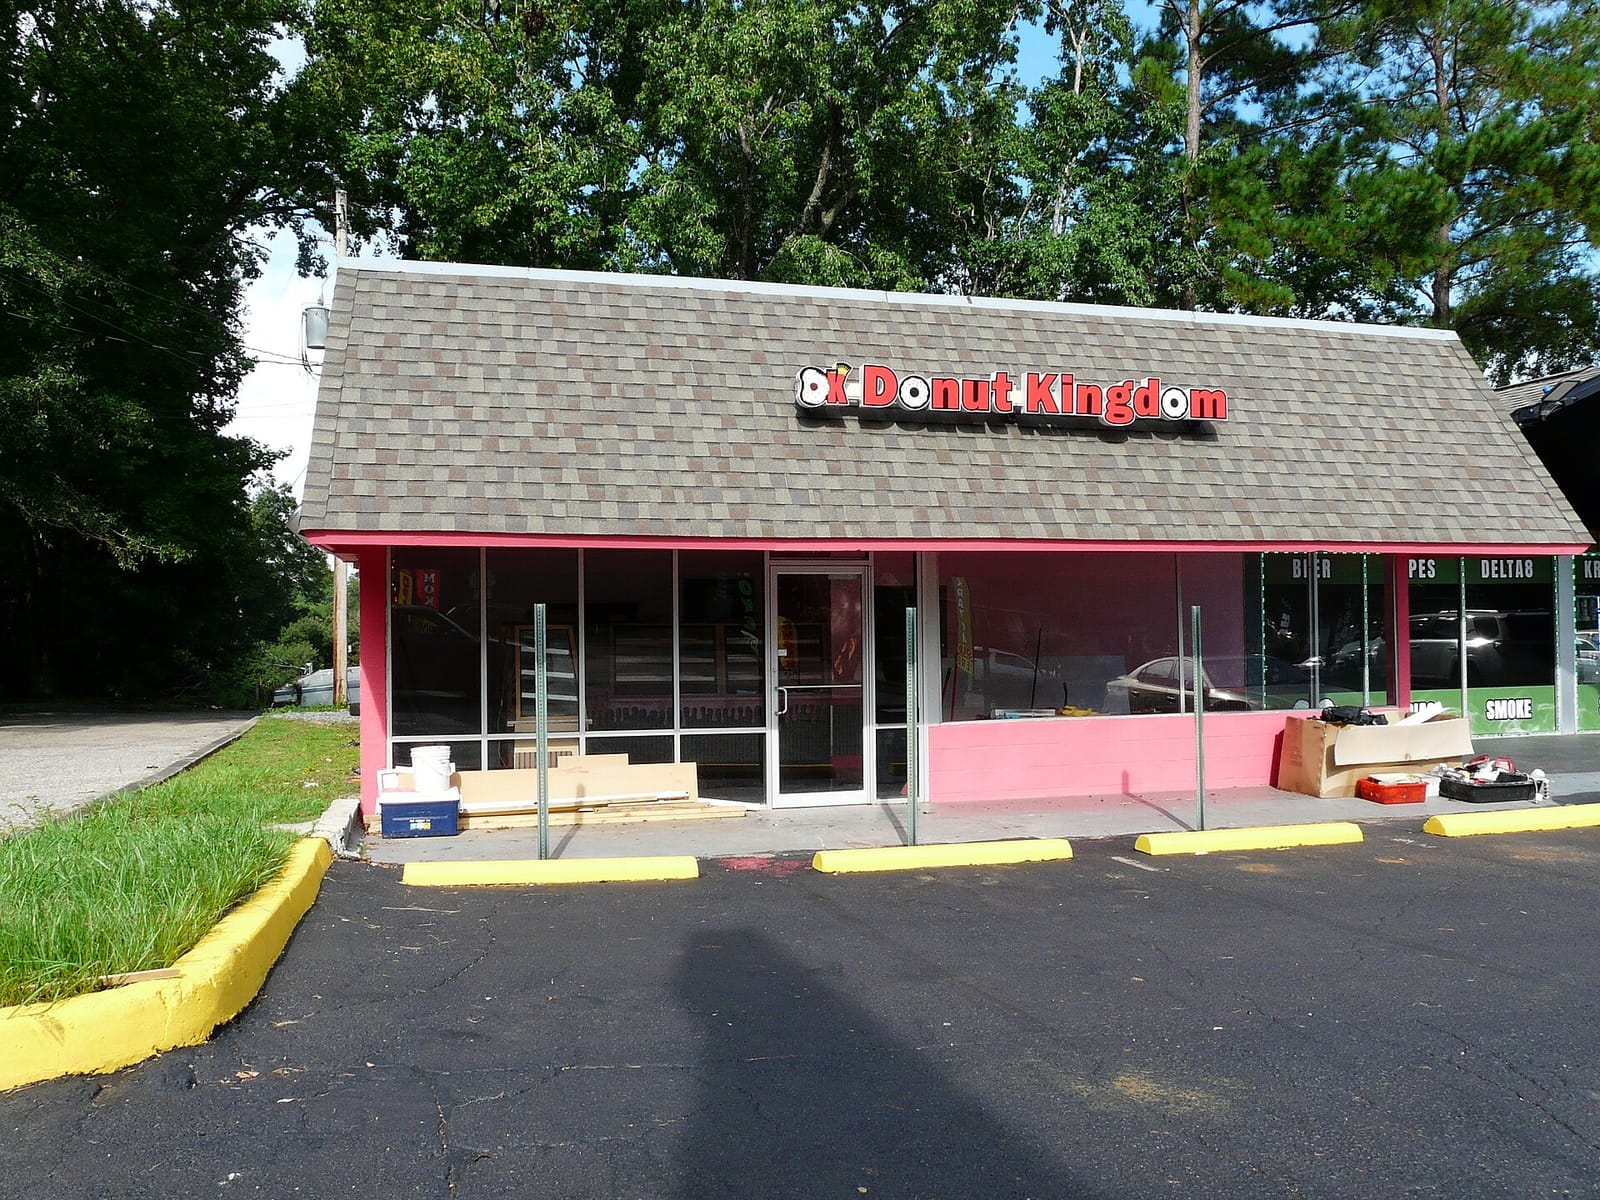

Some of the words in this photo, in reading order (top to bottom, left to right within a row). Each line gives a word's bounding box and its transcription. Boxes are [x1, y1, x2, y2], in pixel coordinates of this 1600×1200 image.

[796, 362, 851, 407] OK
[860, 364, 1011, 412] Donut
[1026, 372, 1228, 426] Kingdom
[1480, 559, 1533, 580] DELTA8
[1486, 698, 1532, 721] SMOKE
